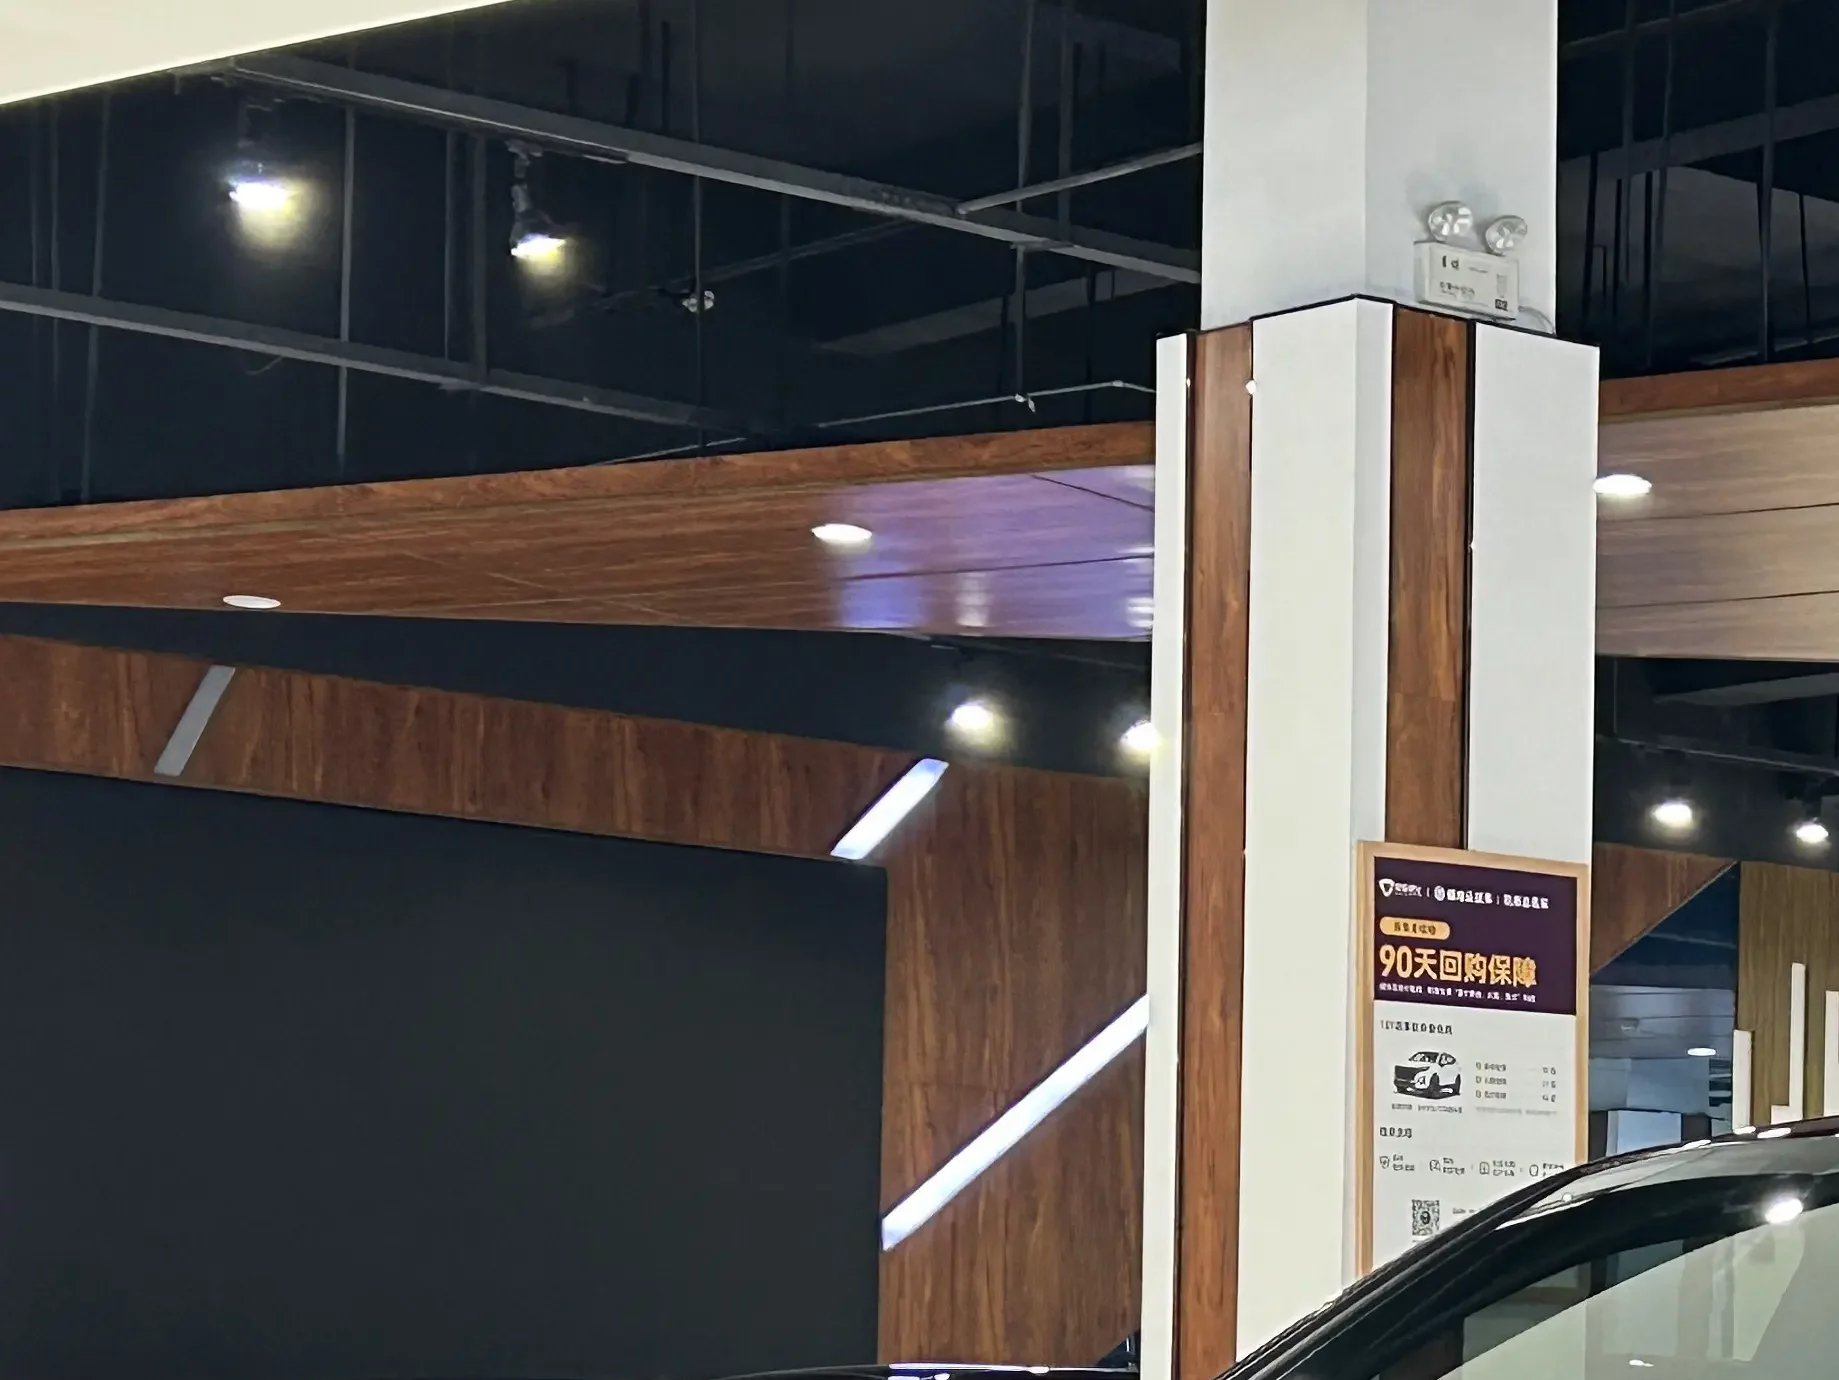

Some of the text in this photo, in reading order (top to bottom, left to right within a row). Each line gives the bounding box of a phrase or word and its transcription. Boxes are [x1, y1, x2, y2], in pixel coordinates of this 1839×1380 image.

[1379, 944, 1538, 988] 90天回购保障
